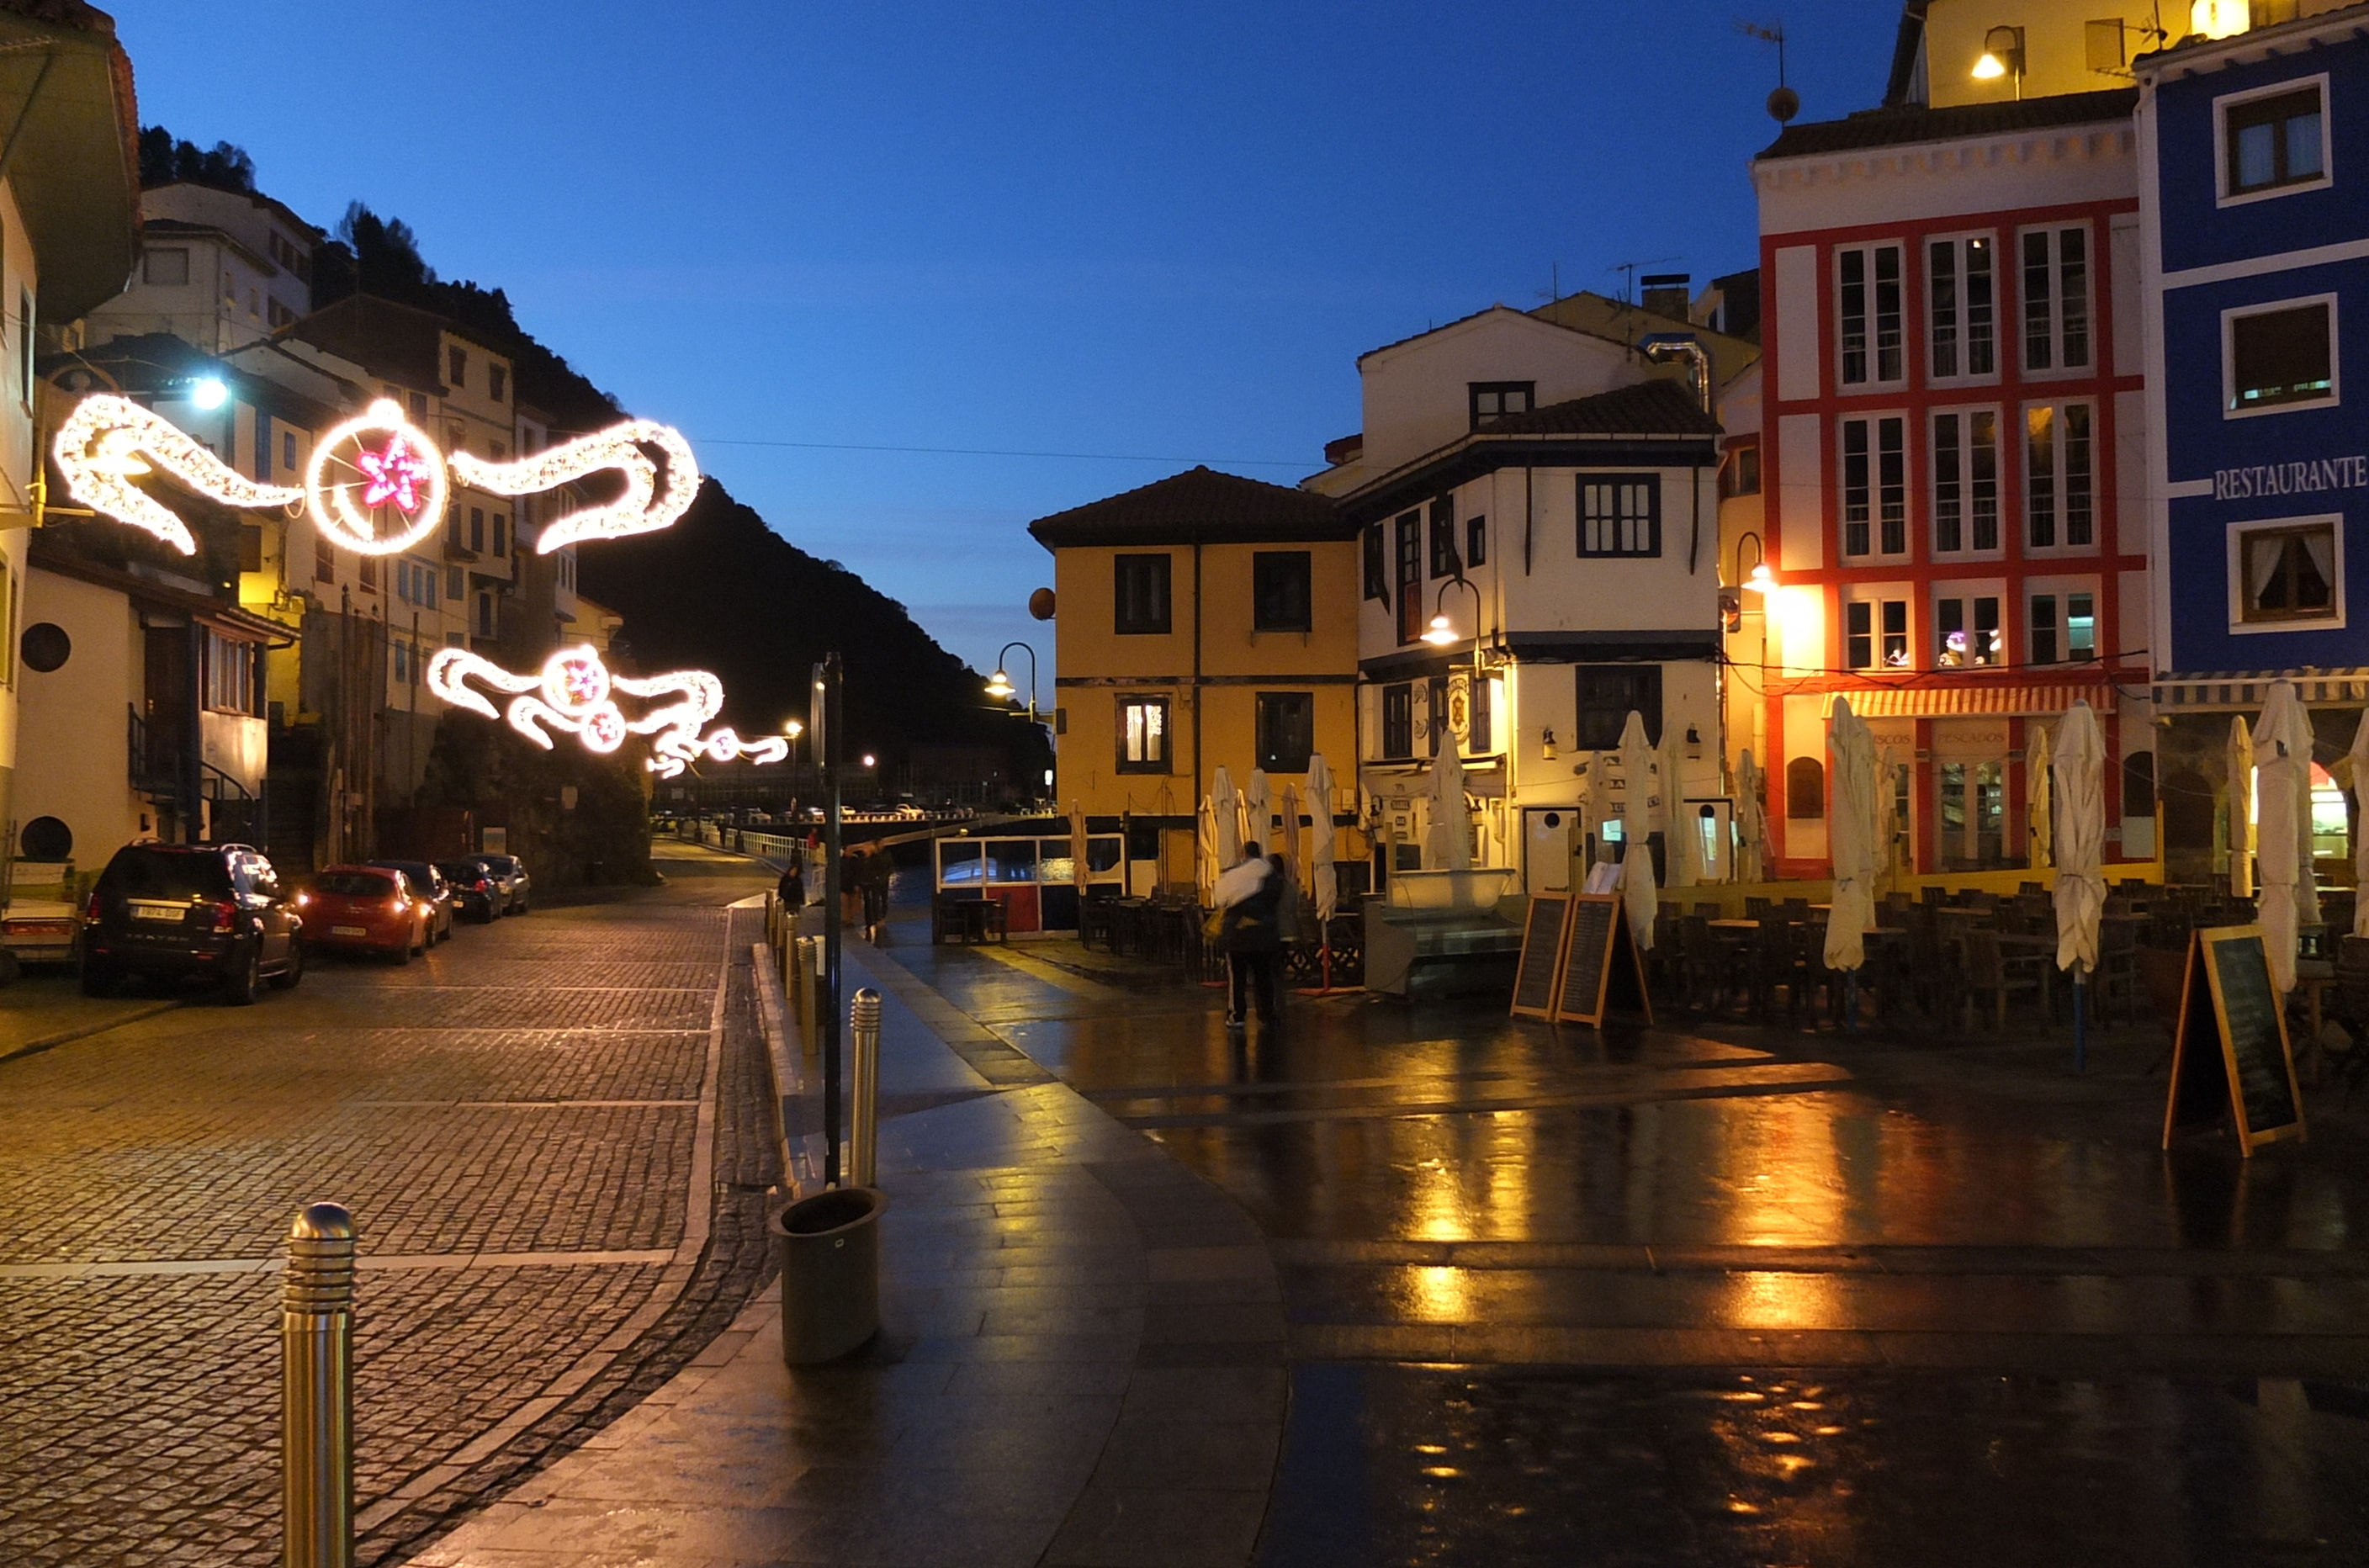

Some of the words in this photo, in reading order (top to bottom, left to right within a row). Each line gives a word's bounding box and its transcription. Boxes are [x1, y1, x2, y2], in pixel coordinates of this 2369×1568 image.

[2215, 455, 2367, 501] RESTAURANTE
[1873, 734, 1911, 745] ISCOS
[1937, 732, 2006, 744] PESCADOS
